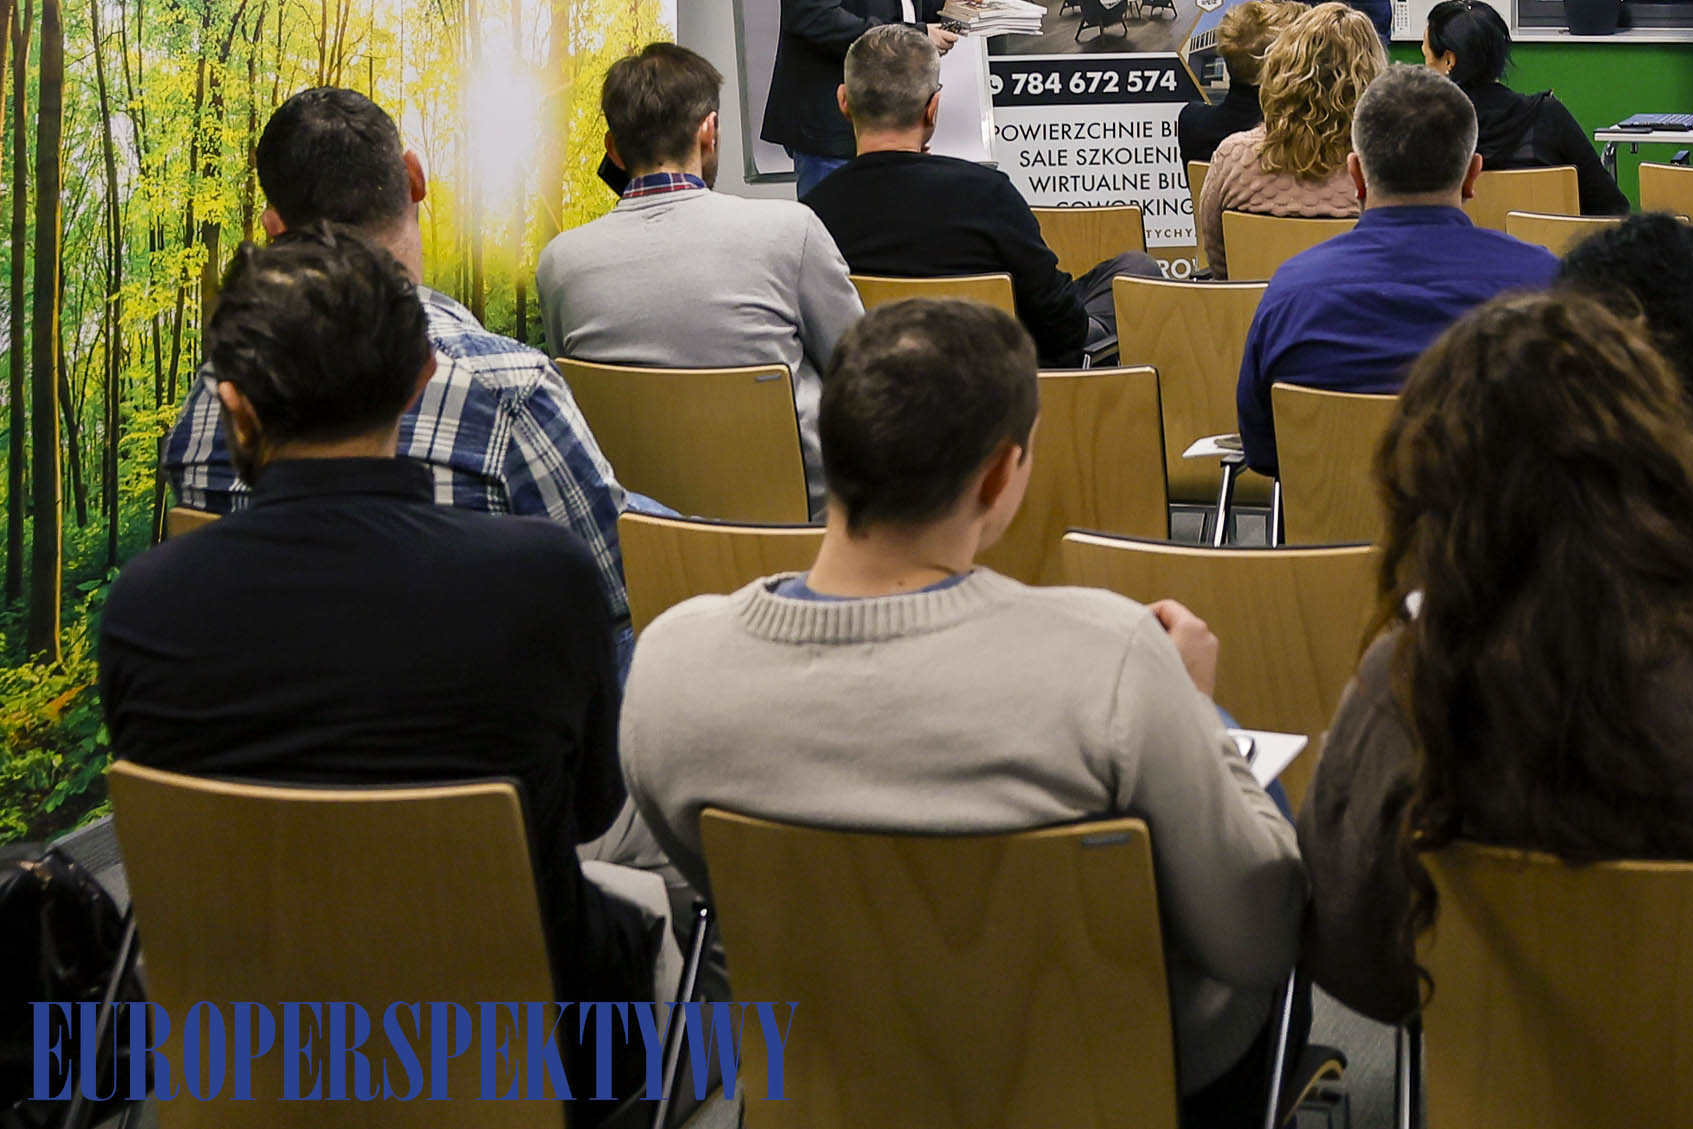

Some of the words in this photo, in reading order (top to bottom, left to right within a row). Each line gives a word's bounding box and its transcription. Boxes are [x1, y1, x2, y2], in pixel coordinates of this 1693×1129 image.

[1011, 72, 1062, 95] 784
[1069, 71, 1120, 94] 672
[1127, 70, 1177, 92] 574
[1161, 121, 1178, 138] BI
[1019, 149, 1068, 168] SALE
[1076, 146, 1178, 166] SZKOLENI
[1028, 173, 1150, 193] WIRTUALNE
[1159, 172, 1189, 190] BIU
[1146, 228, 1197, 239] TYCHY
